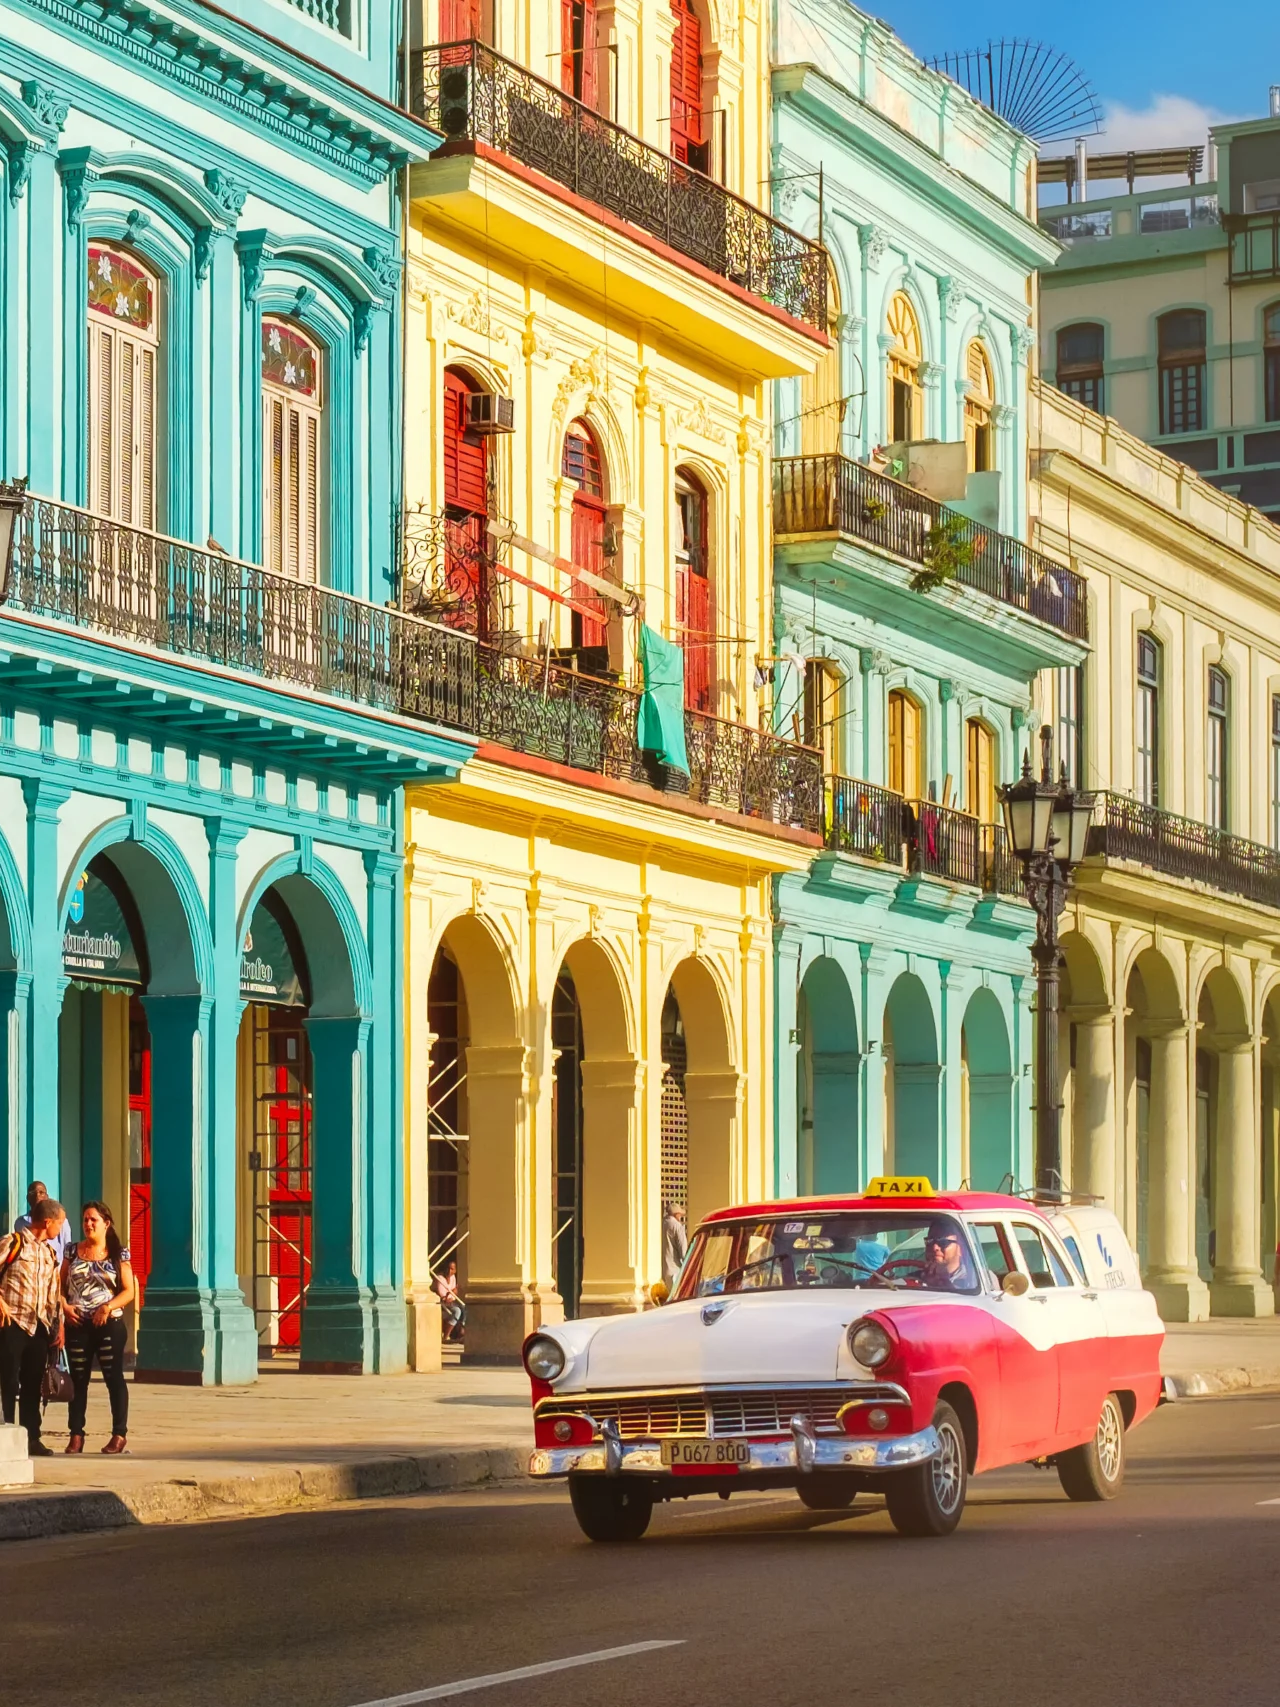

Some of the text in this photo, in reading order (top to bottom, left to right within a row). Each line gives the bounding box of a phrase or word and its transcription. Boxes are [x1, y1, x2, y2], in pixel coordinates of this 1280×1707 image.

[62, 928, 121, 959] sturianito
[876, 1182, 923, 1193] TAXI
[670, 1445, 680, 1463] P
[683, 1444, 711, 1463] 067
[716, 1443, 747, 1462] 800
